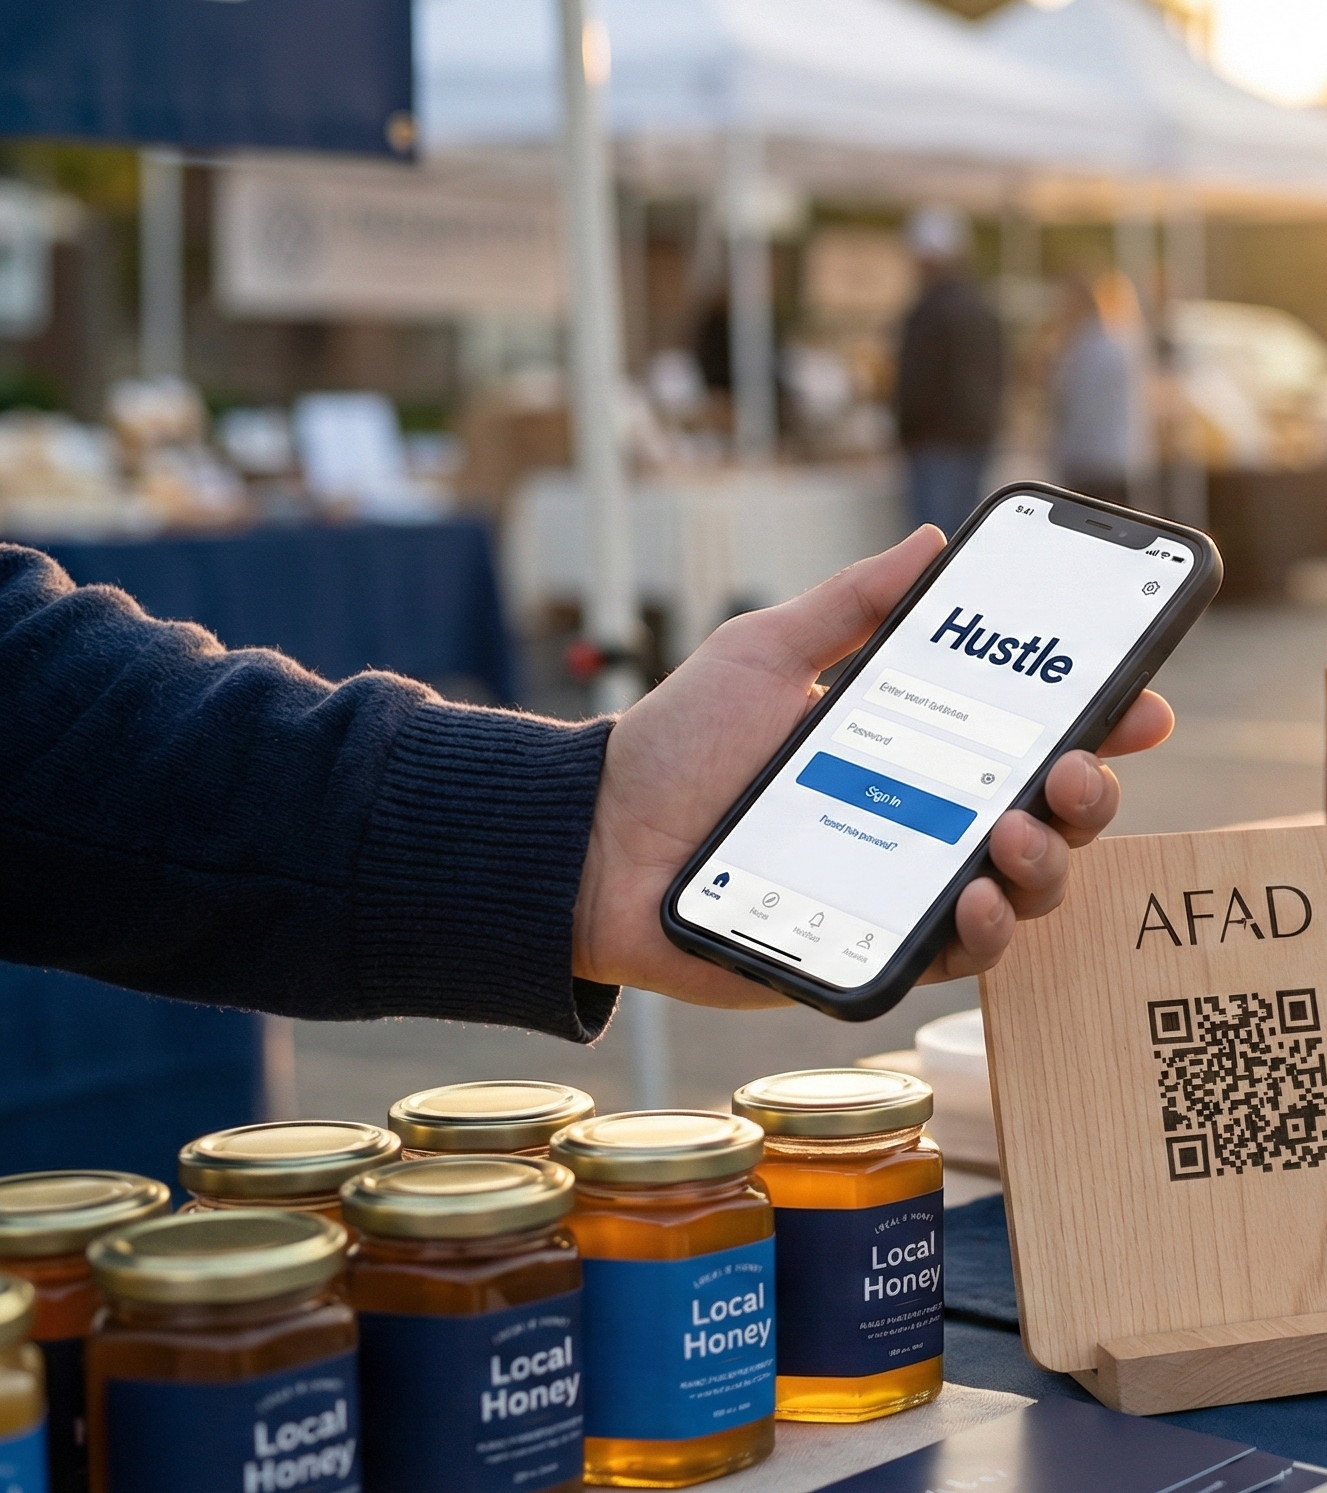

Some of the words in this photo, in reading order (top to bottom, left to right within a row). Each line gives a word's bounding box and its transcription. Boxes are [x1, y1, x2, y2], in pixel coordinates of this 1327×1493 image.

[930, 606, 1074, 684] Hustle
[1135, 885, 1313, 950] AFAD
[871, 1230, 935, 1270] Local
[692, 1282, 764, 1326] Local
[864, 1264, 941, 1302] Honey
[490, 1335, 573, 1387] Local
[683, 1317, 772, 1360] Honey
[481, 1372, 581, 1424] Honey
[254, 1398, 347, 1458] Local
[243, 1438, 357, 1493] Honey
